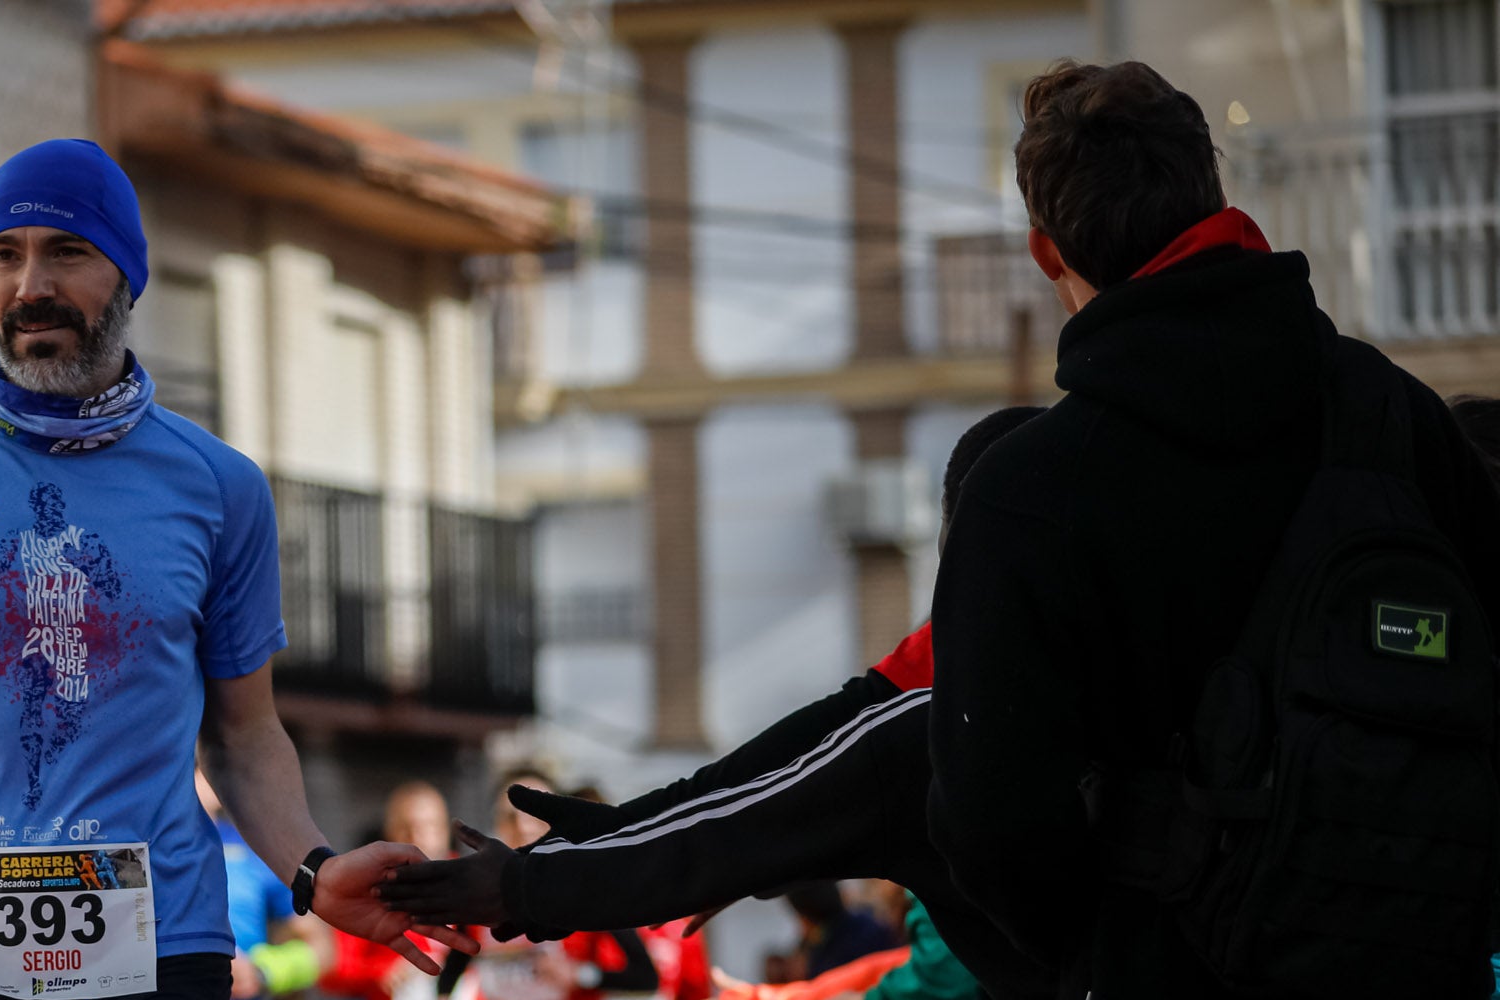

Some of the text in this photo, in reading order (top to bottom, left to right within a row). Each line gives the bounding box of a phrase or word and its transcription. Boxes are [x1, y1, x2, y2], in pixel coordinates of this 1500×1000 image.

[21, 553, 73, 578] FONS
[26, 587, 86, 627] PATERNA
[56, 627, 83, 643] SEP
[22, 627, 55, 665] 28
[56, 641, 88, 660] TIEM
[56, 656, 86, 675] BRE
[57, 672, 89, 702] 2014
[0, 855, 74, 868] CARRERA
[1, 867, 75, 878] POPULAR
[23, 949, 82, 972] SERGIO
[47, 977, 88, 987] olimpo
